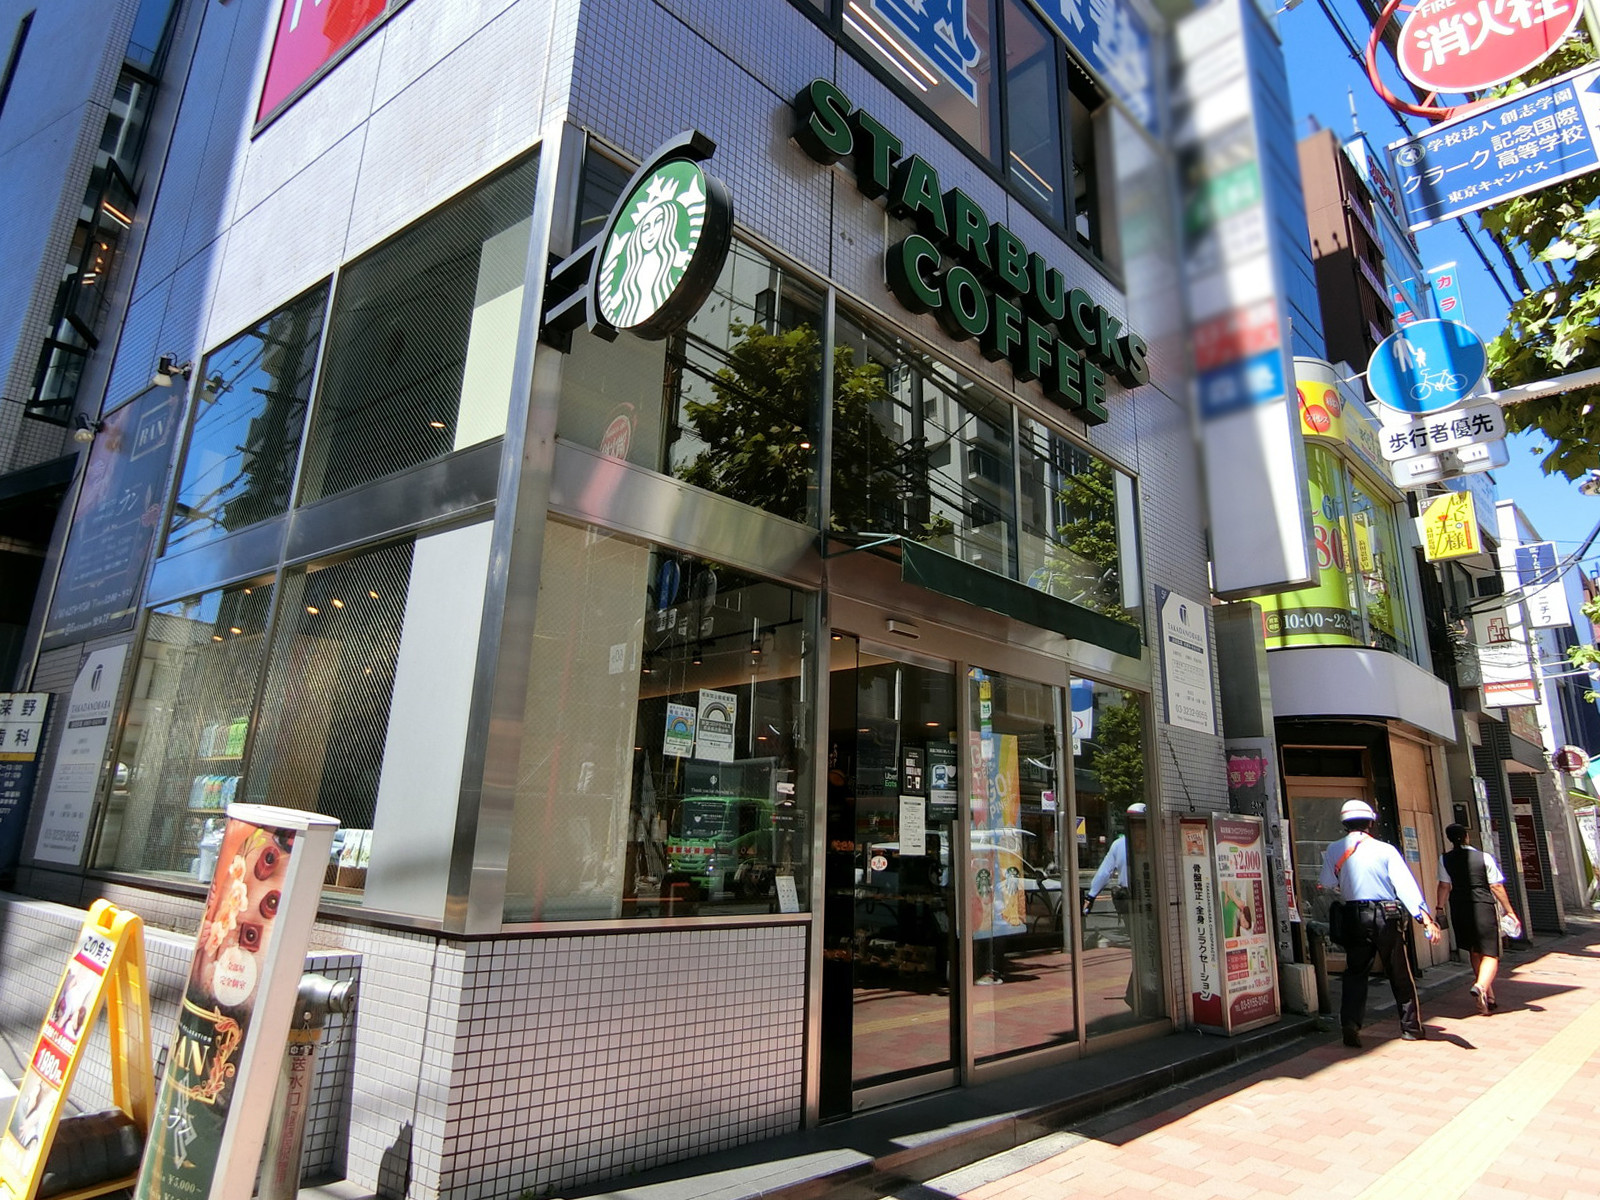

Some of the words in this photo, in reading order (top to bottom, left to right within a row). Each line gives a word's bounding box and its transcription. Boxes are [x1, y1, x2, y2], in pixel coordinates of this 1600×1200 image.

[1421, 0, 1456, 18] FIRE
[1427, 119, 1497, 152] 学校法人
[1500, 87, 1573, 126] 創志学園
[1402, 149, 1491, 194] クラーク
[1490, 106, 1580, 153] 記念国際
[1495, 124, 1587, 169] 高等学校
[1448, 160, 1549, 204] 東京キャンパス
[803, 78, 1150, 387] STARBUCKS
[897, 234, 1108, 425] COFFEE
[1388, 413, 1495, 453] 歩行者優先
[884, 772, 898, 780] Uber
[884, 780, 898, 788] Eats
[286, 1057, 307, 1107] 送水口
